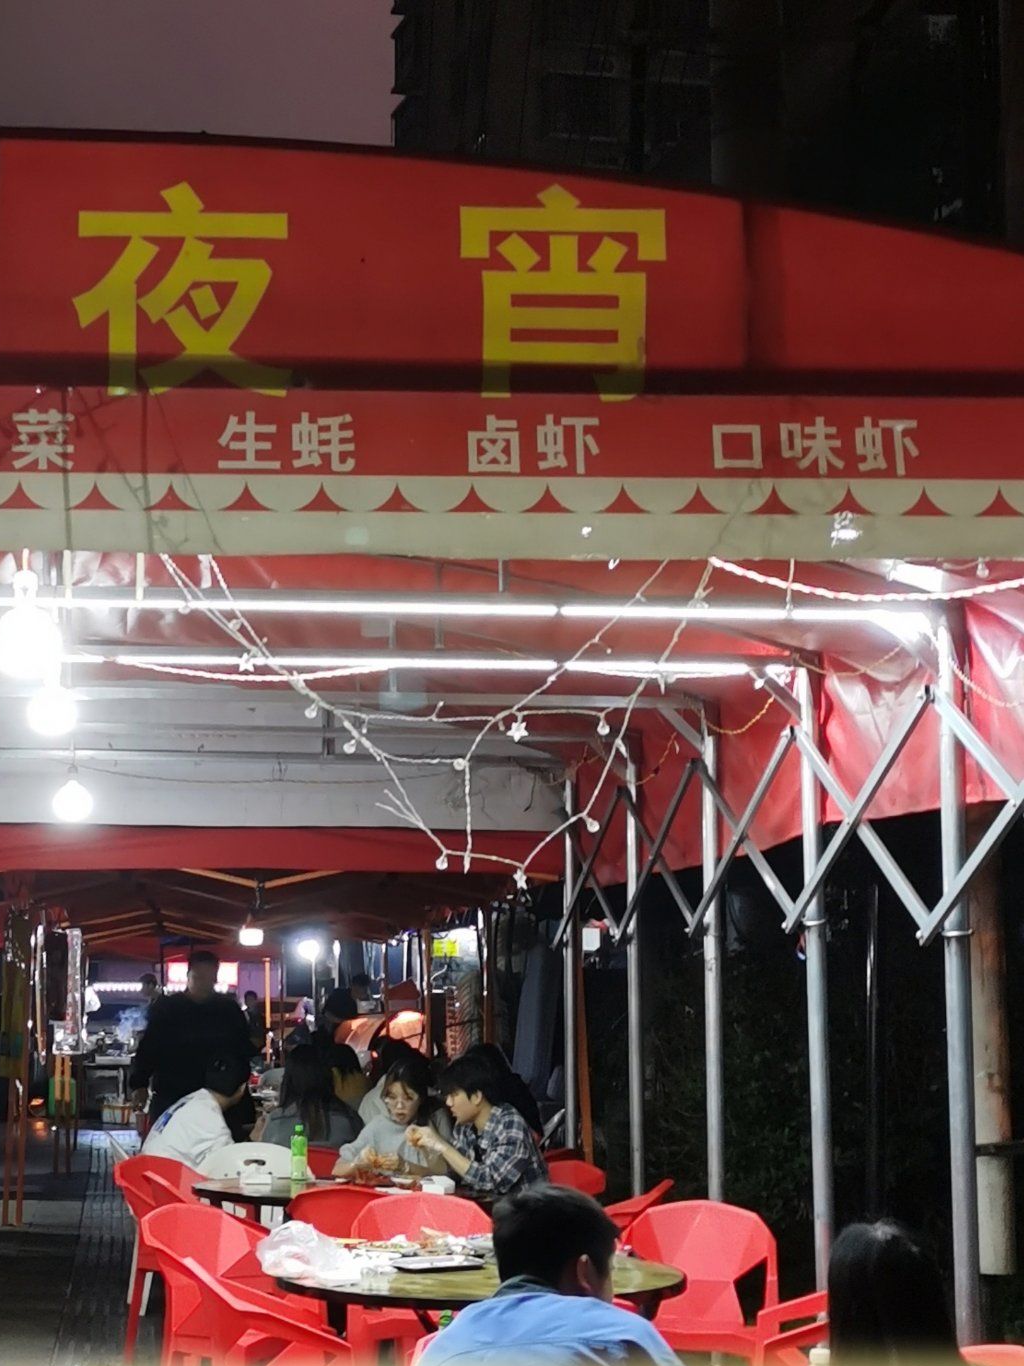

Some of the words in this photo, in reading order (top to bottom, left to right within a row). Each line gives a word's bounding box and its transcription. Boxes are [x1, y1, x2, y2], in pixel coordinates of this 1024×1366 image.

[217, 411, 356, 473] 生蚝
[467, 414, 600, 474] 卤虾
[711, 416, 919, 477] 口味虾
